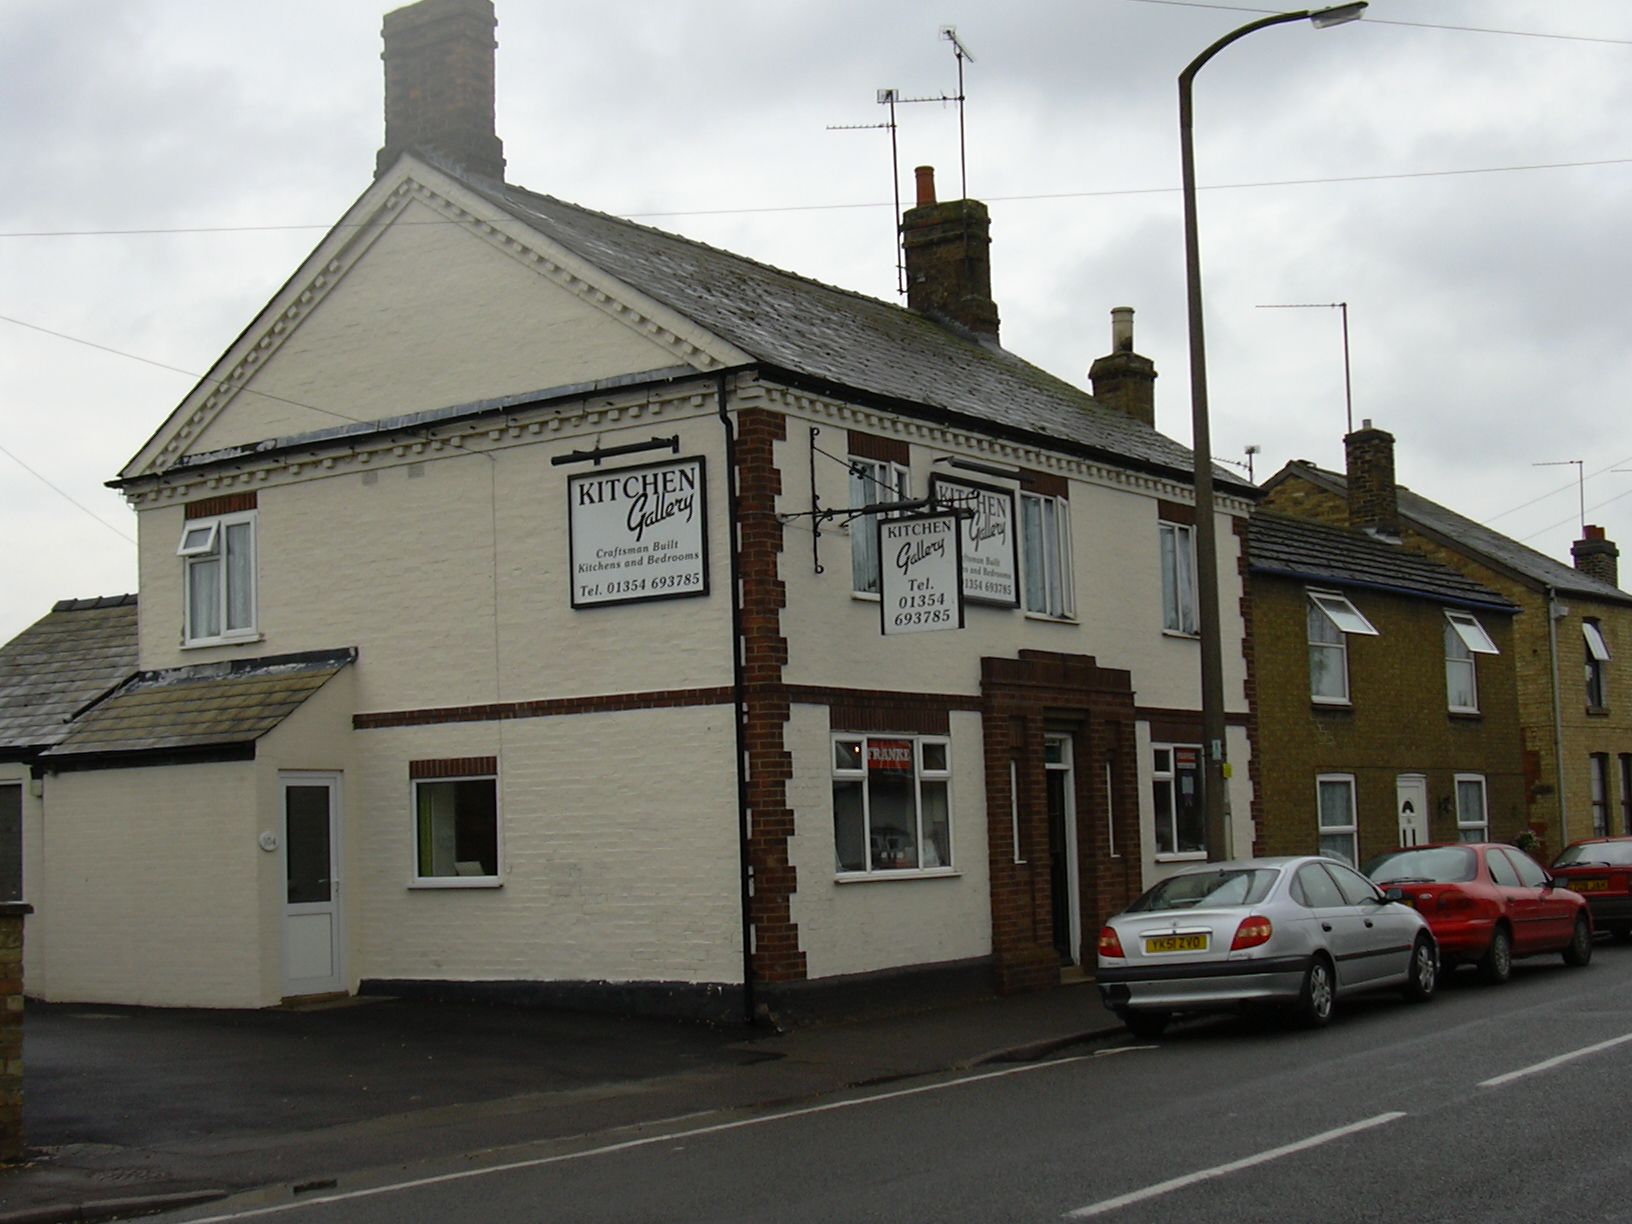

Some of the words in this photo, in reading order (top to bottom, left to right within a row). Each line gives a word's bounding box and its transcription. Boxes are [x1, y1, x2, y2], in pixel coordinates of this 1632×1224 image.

[578, 467, 696, 505] KITCHEN
[627, 492, 694, 542] Gallery
[888, 520, 952, 538] KITCHEN
[969, 510, 1006, 552] Gallery
[596, 545, 649, 558] Craftsman
[653, 540, 678, 552] Built
[896, 539, 944, 575] Gallery
[578, 562, 621, 573] Kitchens
[624, 556, 643, 567] and
[647, 552, 699, 565] Bedrooms
[580, 584, 602, 597] Tel.
[607, 578, 646, 594] 01354
[651, 573, 700, 589] 693785
[908, 577, 934, 591] Tel.
[964, 578, 983, 591] 1354
[985, 581, 1012, 595] 693785
[899, 593, 944, 609] 01354
[894, 609, 950, 626] 693785
[867, 747, 911, 761] FRANKE
